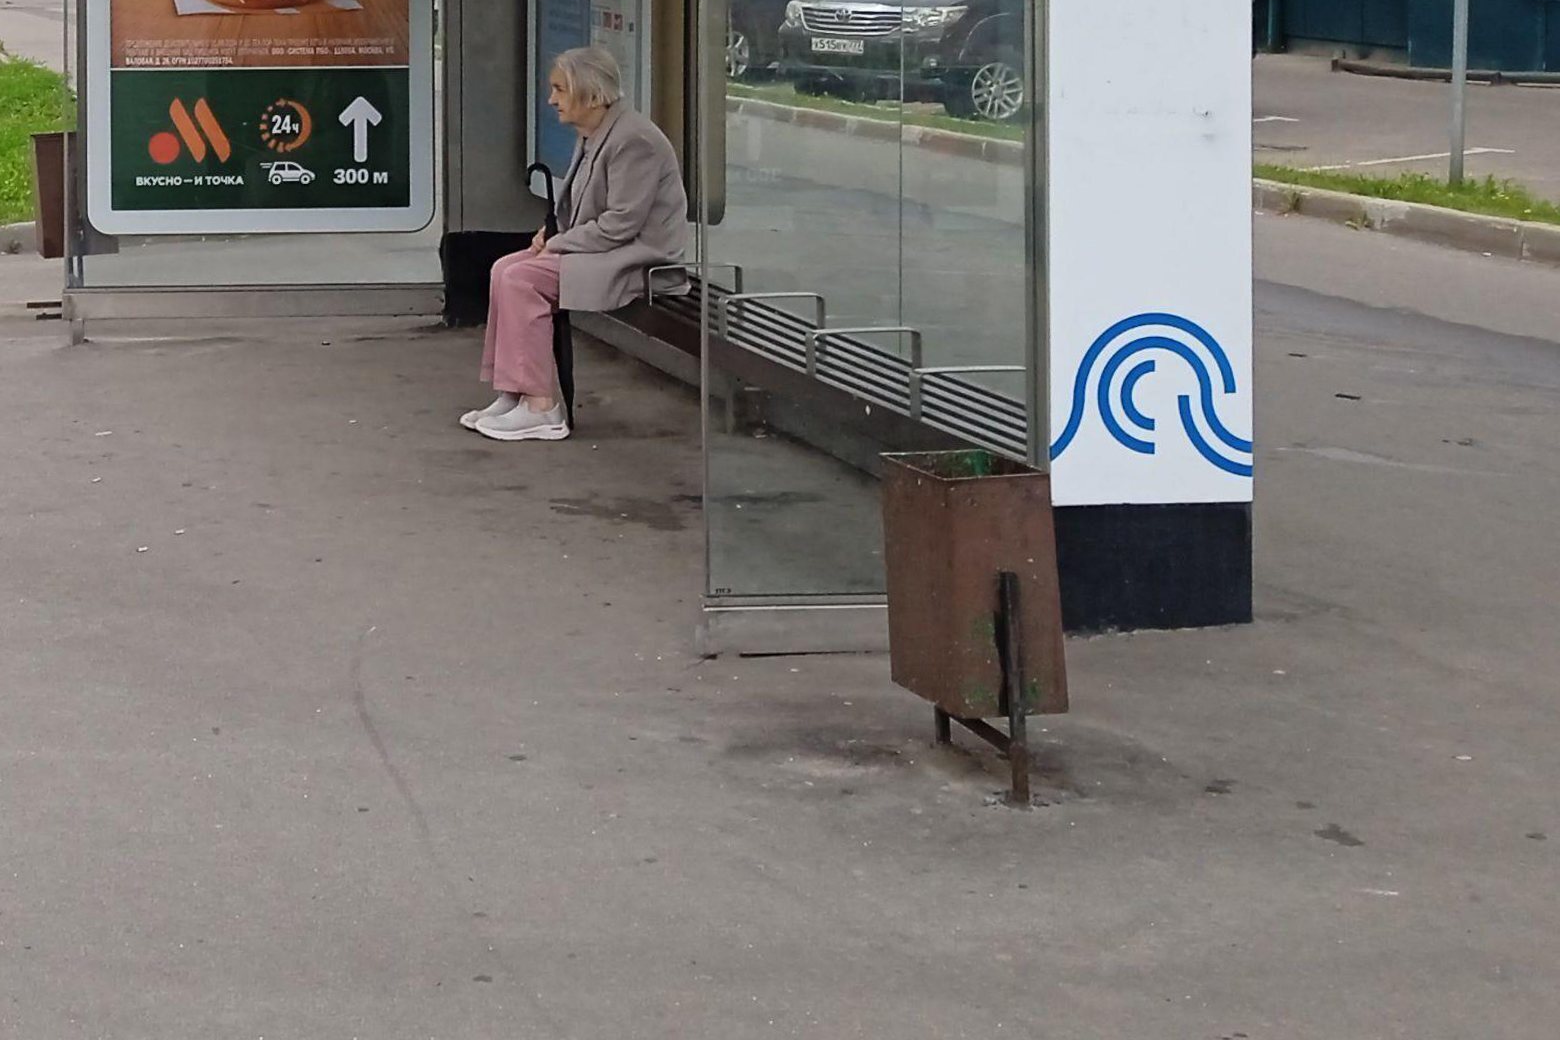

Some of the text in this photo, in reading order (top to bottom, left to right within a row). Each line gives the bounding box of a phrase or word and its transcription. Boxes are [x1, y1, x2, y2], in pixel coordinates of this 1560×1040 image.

[135, 176, 182, 186] ВКУСНО
[205, 176, 244, 186] ТОЧКА
[333, 169, 369, 185] 300
